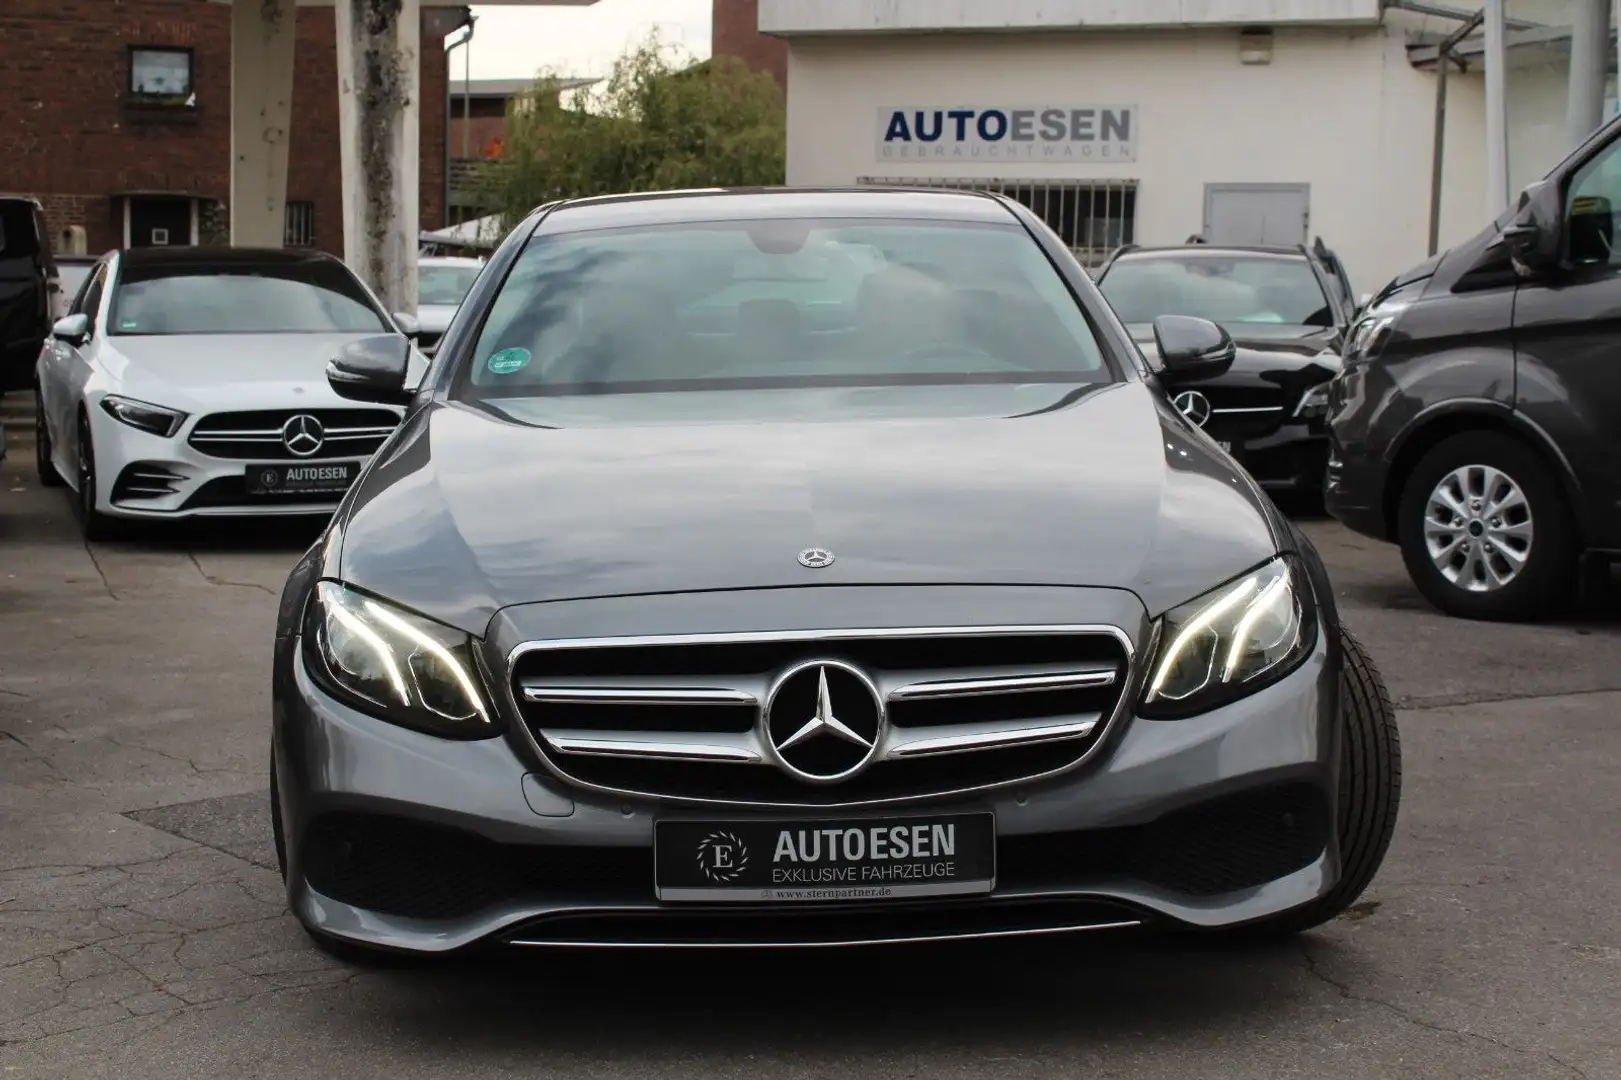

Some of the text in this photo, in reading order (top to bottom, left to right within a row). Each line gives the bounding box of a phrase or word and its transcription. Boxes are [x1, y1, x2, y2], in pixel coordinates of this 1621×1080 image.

[884, 109, 1130, 142] AUTOESEN
[882, 145, 1130, 158] GEBRAUCHTWAGEN
[286, 467, 347, 480] AUTOESEN
[772, 824, 955, 862] AUTOESEN
[712, 845, 733, 868] E
[772, 862, 955, 883] EXKLUSIVE FAHRZEUGE
[776, 887, 892, 899] www.sternpartner.de
